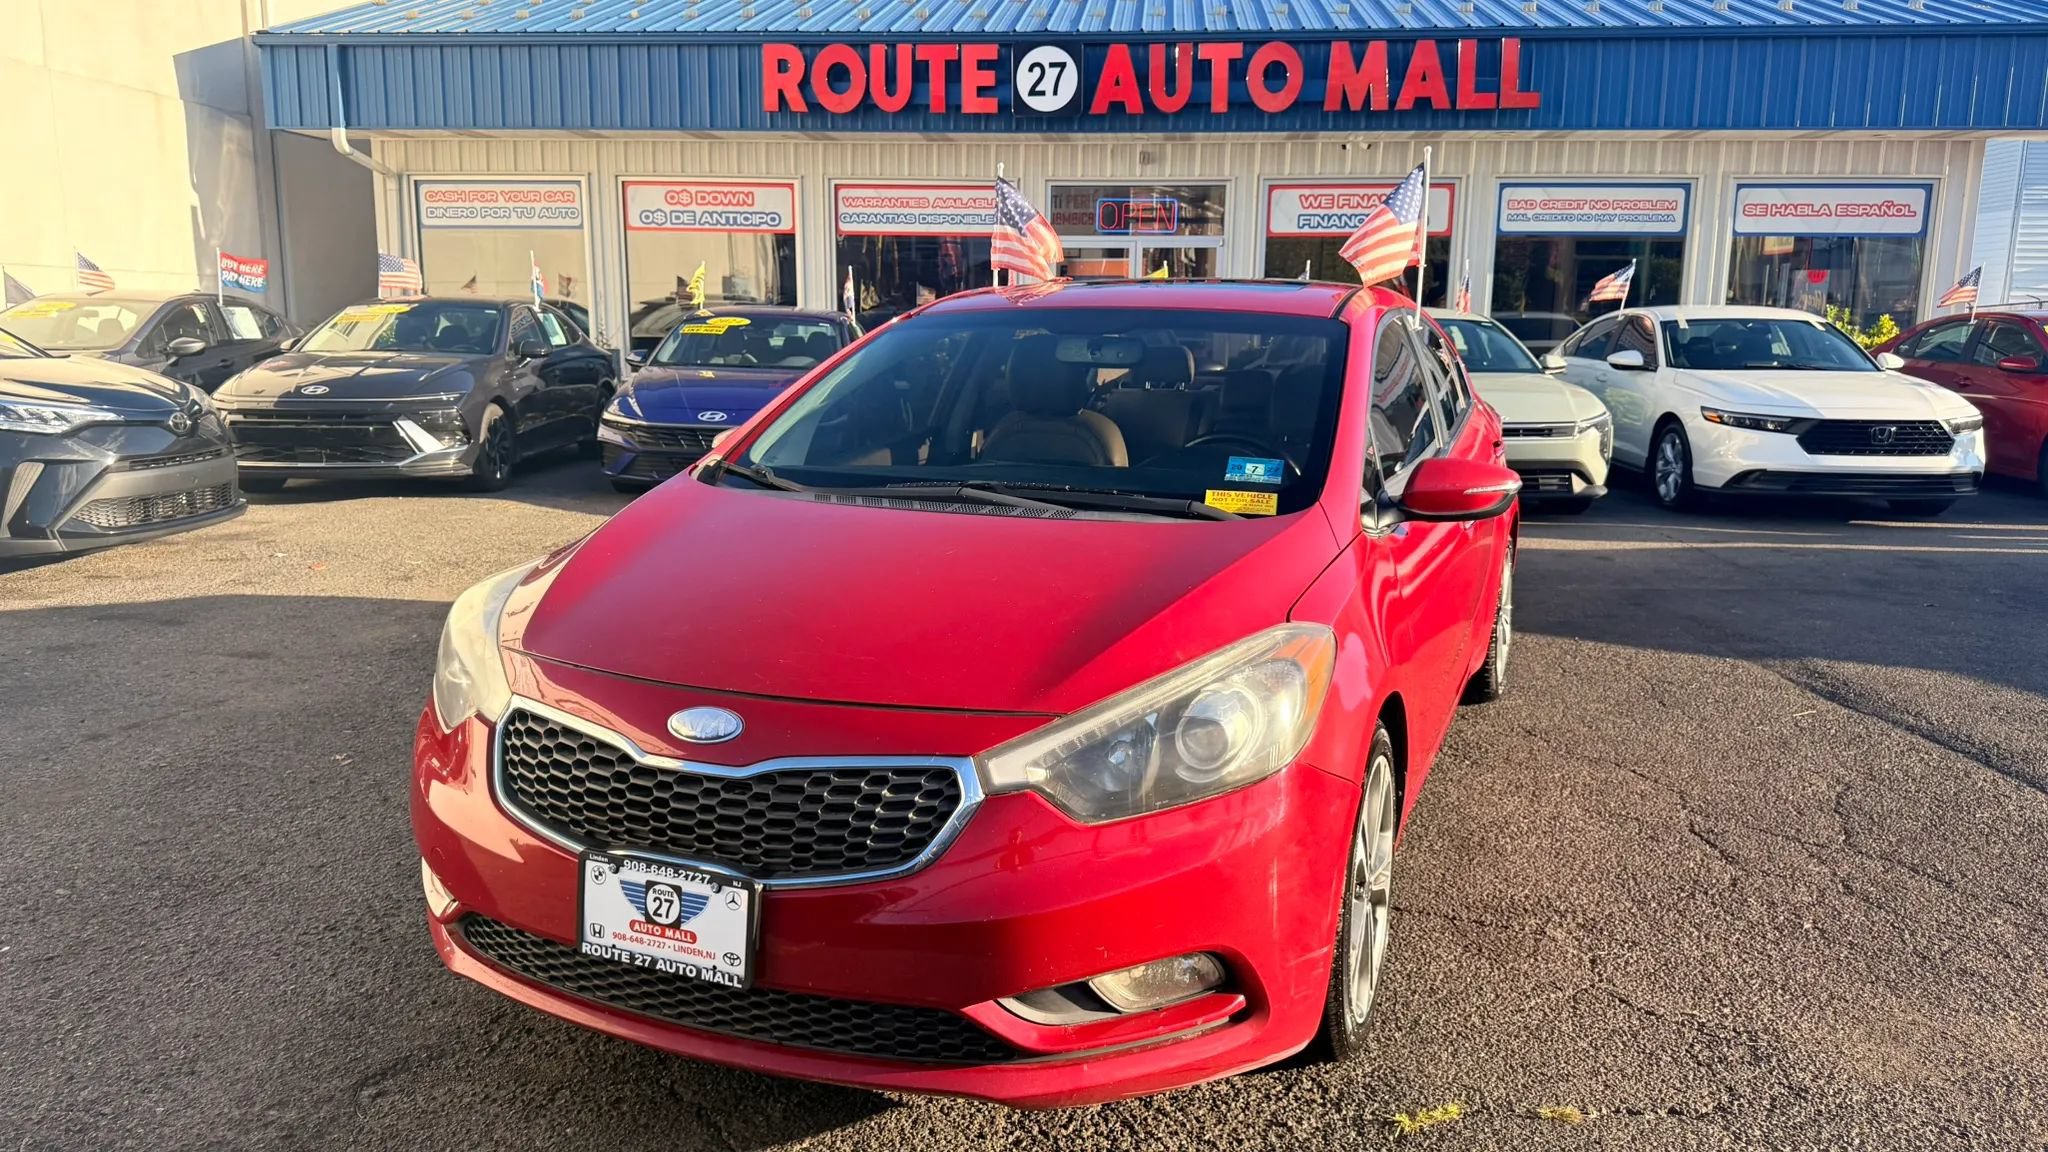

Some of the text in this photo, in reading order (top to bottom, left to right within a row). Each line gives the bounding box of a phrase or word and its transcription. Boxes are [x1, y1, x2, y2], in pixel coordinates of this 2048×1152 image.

[762, 37, 1541, 114] ROUTE 27 AUTO MALL
[425, 190, 576, 203] CASH FOR YOUR CAR
[695, 191, 755, 206] DOWN
[842, 196, 929, 209] WARRANTIES
[1299, 193, 1334, 210] WE
[426, 207, 579, 219] DINERO POR TU AUTO
[1507, 200, 1678, 211] BAD CREDIT NO PROBLEM
[1743, 200, 1916, 217] SE HABLA ESPAÑOL
[669, 210, 696, 225] DE
[698, 210, 781, 227] ANTICIPO
[839, 212, 916, 225] GARANTIAS
[1100, 201, 1175, 231] OPEN
[1506, 213, 1676, 223] MAL CREDITO NO HAY PROBLEMA
[239, 263, 265, 274] HERE
[221, 270, 265, 287] PAY HERE
[1234, 492, 1273, 500] VEHICLE
[588, 853, 609, 863] Linden
[623, 859, 712, 885] 908-648-2727
[732, 880, 742, 888] NJ
[652, 887, 675, 898] ROUTE
[652, 896, 675, 919] 27
[632, 921, 694, 943] AUTO MALL
[612, 931, 666, 950] 908-648-2727
[581, 942, 743, 989] ROUTE 27 AUTO MALL
